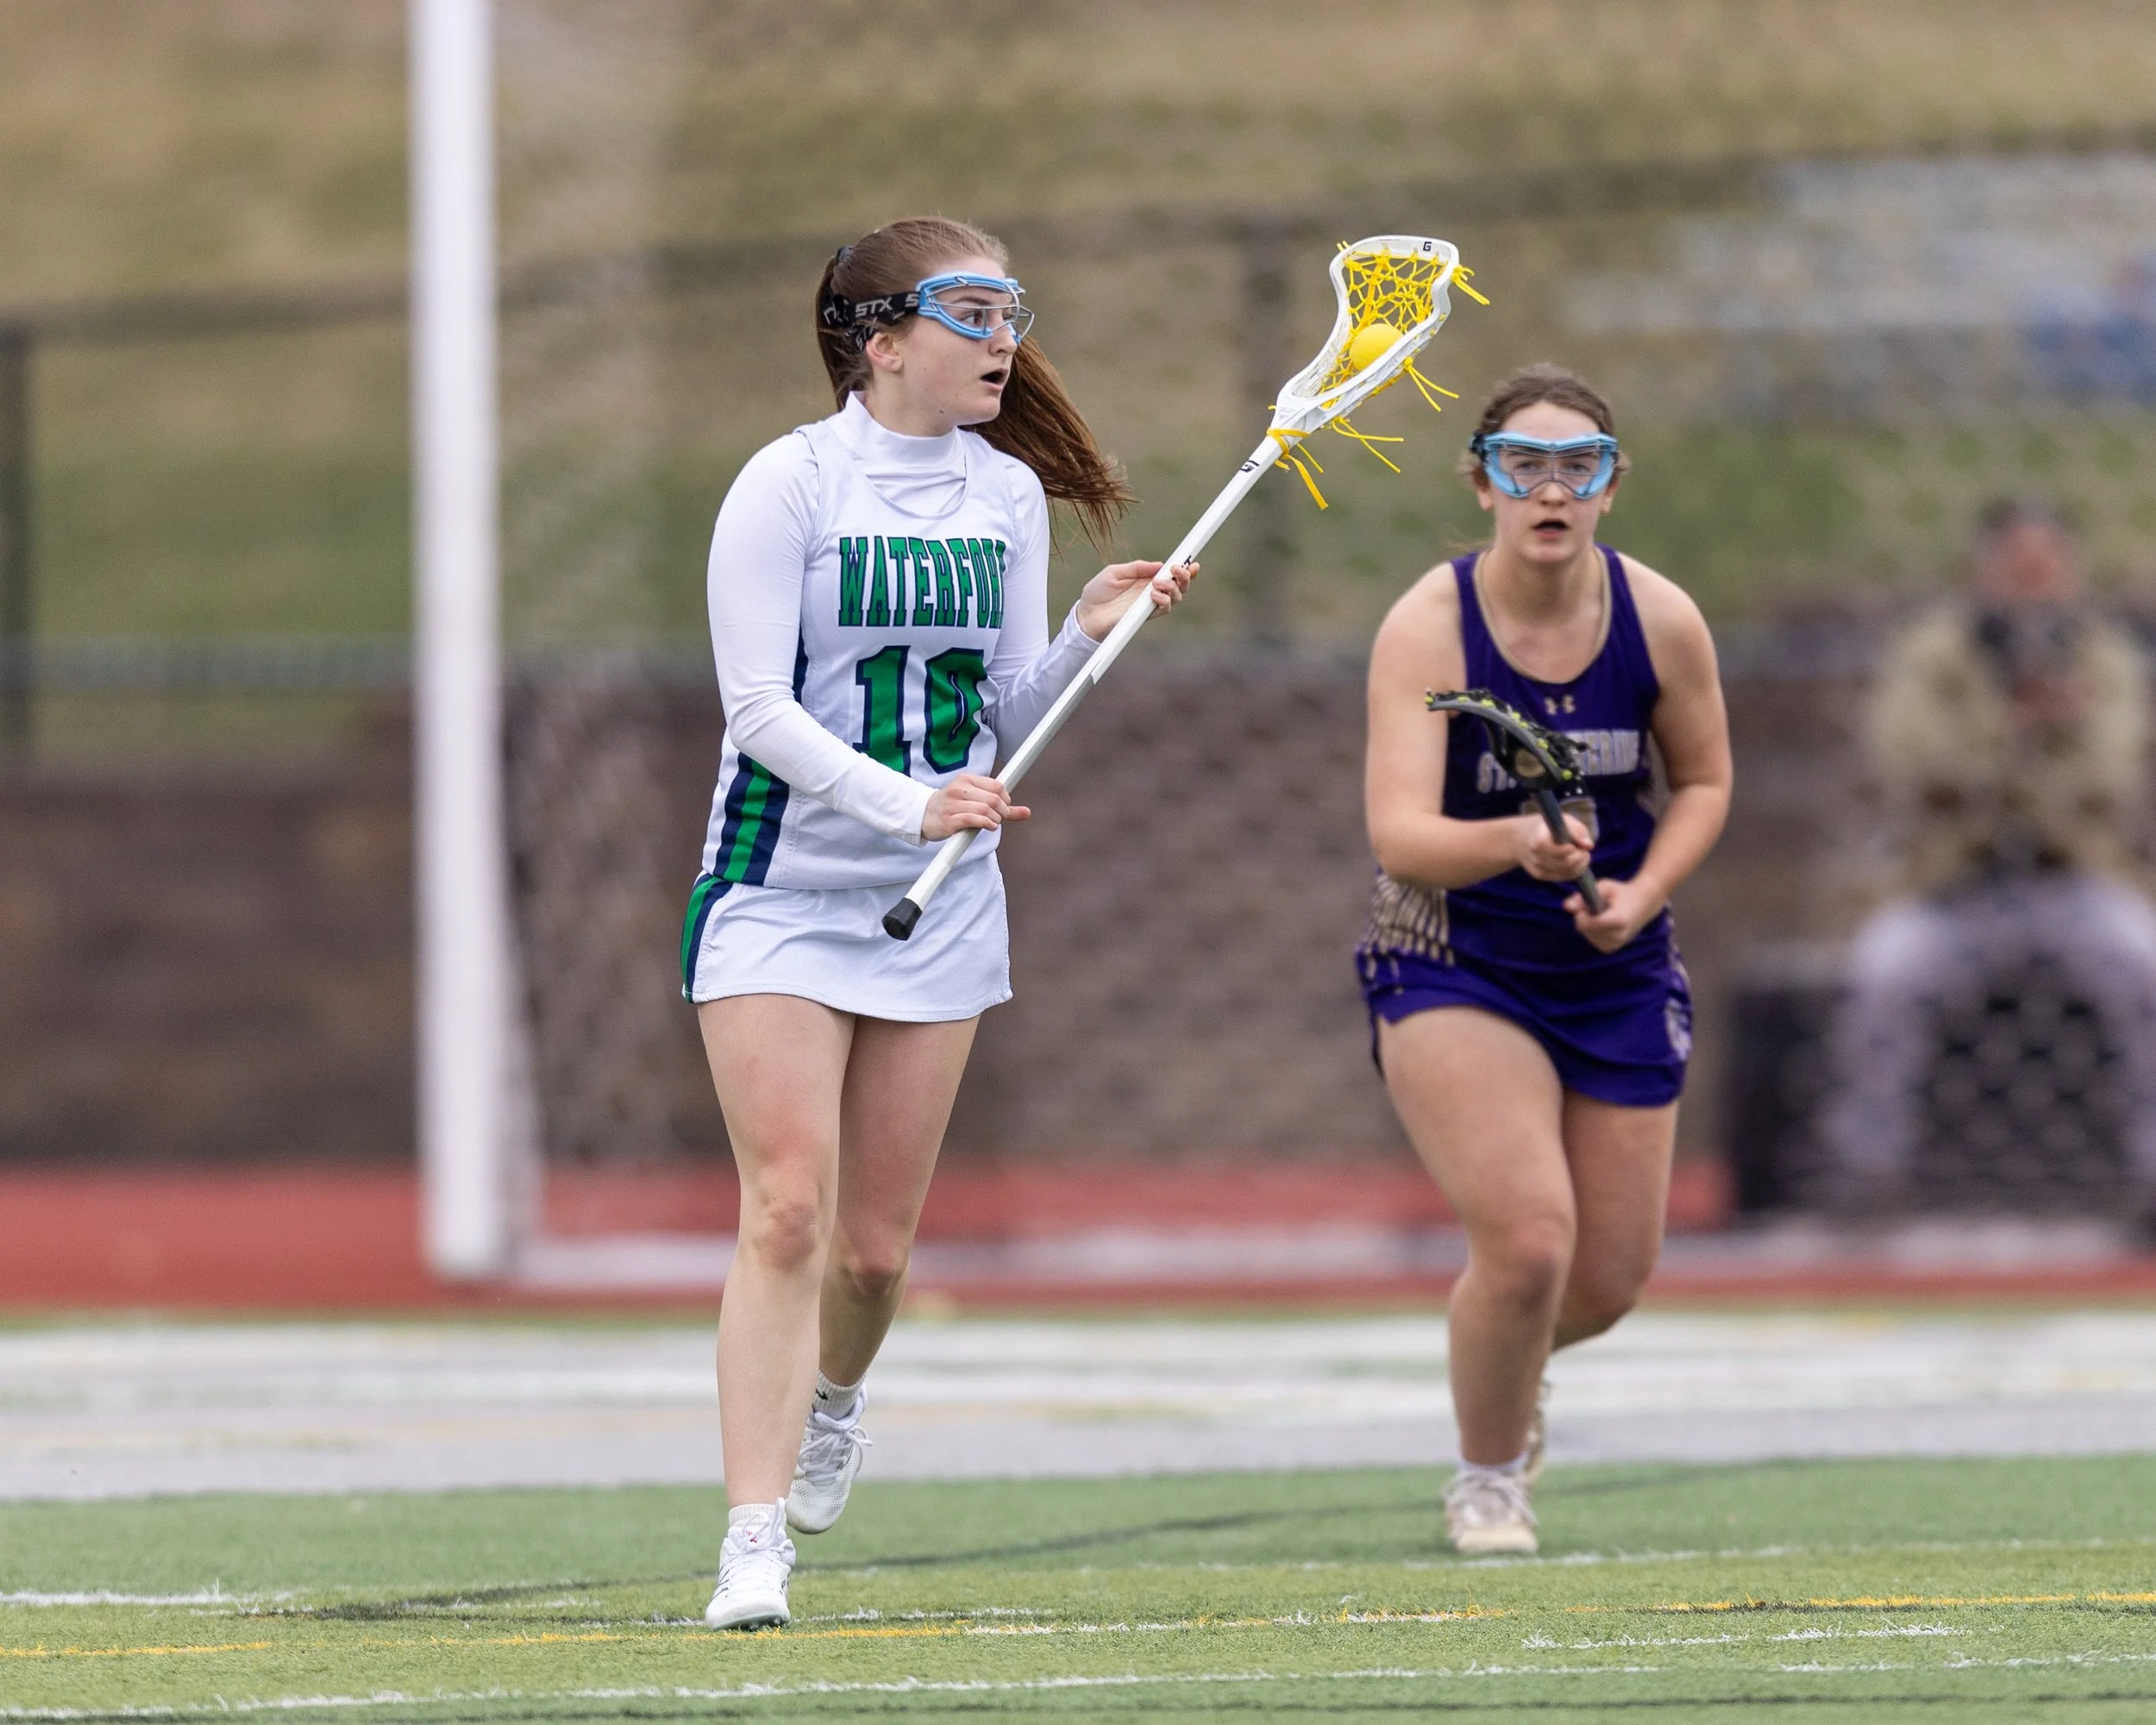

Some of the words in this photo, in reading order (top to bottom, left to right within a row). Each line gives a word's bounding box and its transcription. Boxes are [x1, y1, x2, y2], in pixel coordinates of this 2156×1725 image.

[1423, 241, 1432, 252] G
[856, 296, 893, 318] STX
[852, 645, 988, 778] 10
